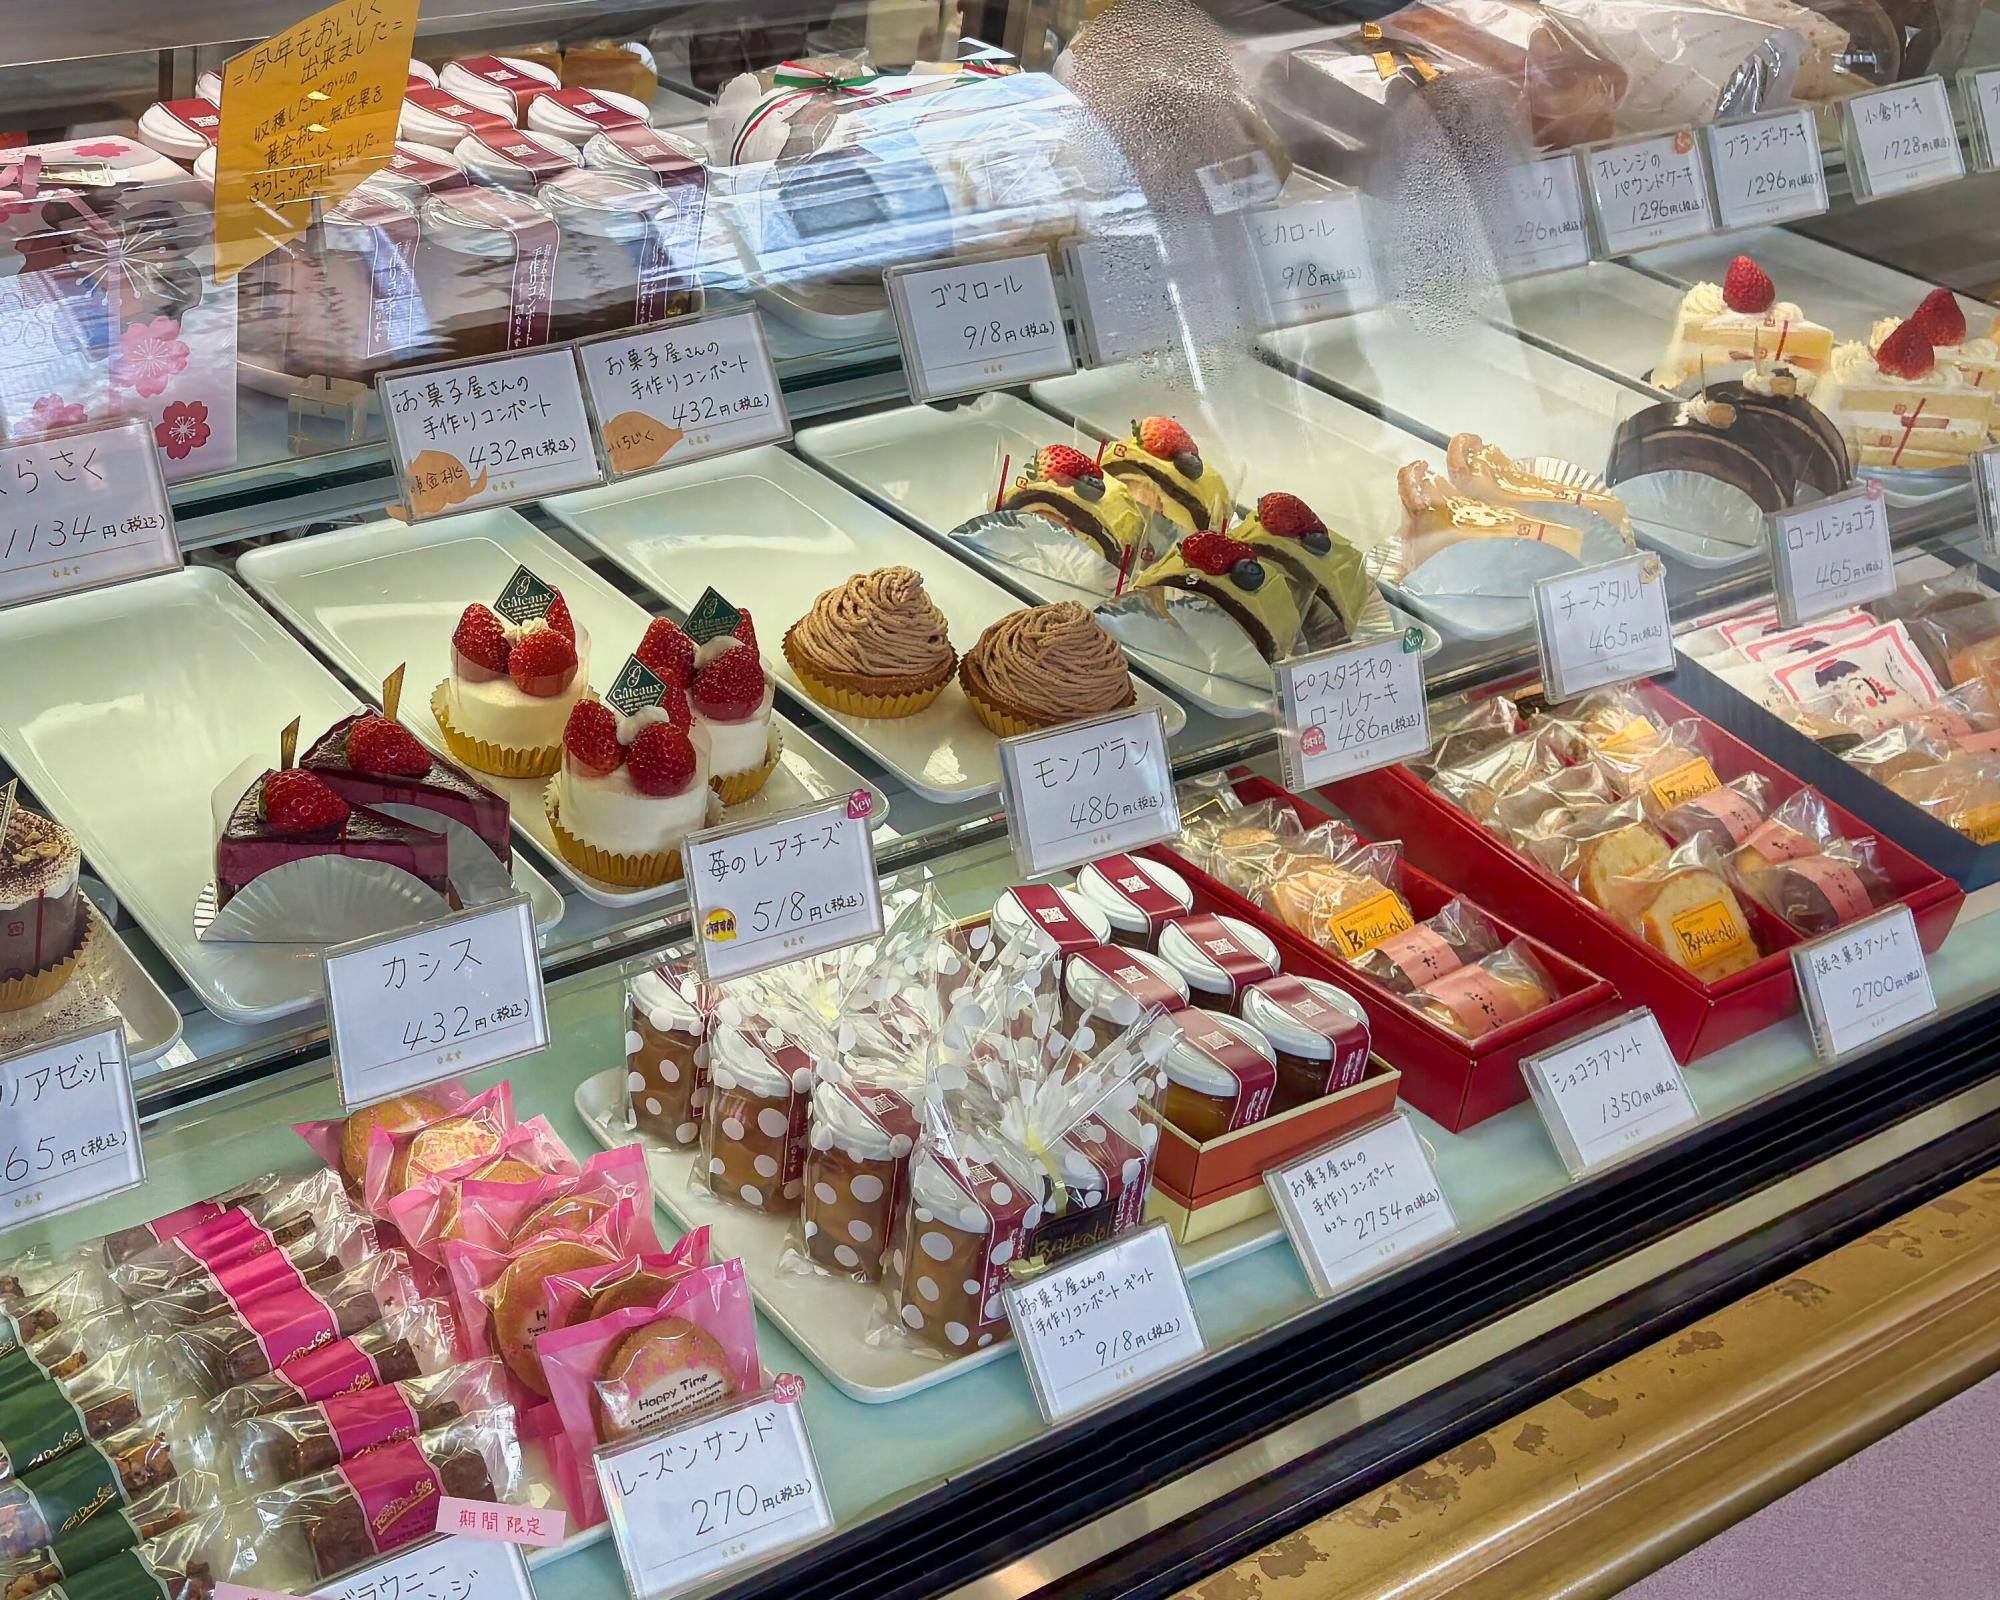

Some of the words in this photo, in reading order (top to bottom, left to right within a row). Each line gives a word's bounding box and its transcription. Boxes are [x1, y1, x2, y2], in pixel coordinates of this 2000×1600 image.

[929, 274, 1024, 309] ゴマロール
[962, 320, 1056, 350] 918円(税込)
[604, 341, 720, 377] お菓子屋さんの
[630, 354, 749, 401] 手作りコンポート
[391, 375, 530, 414] お菓子屋さんの
[423, 393, 553, 441] 手作りコンポート
[671, 393, 770, 428] 432円(税込)
[467, 436, 577, 471] 432円(税込)
[1293, 657, 1393, 703] ピスタチオの
[1310, 682, 1399, 728] ロールケーキ
[1032, 736, 1150, 789] モンブラン
[1069, 791, 1165, 830] 486円(税込)
[707, 820, 843, 883] 苺のレアチーズ
[751, 890, 866, 933] 518円(税込)
[381, 937, 483, 990] カシス
[401, 998, 531, 1052] 432円(税込)
[1551, 1035, 1643, 1094] ショコラアソート
[0, 1130, 128, 1183] 65円(税込)
[1290, 1151, 1367, 1199] お菓子屋さんの
[1312, 1160, 1396, 1217] 手作りコンポート
[1016, 1270, 1106, 1317] お菓子屋さんの
[638, 1386, 678, 1411] Happy
[680, 1372, 709, 1392] Time
[611, 1411, 776, 1497] レーズンサンド
[458, 1509, 547, 1538] 期間限定
[690, 1478, 813, 1537] 270円(税込)
